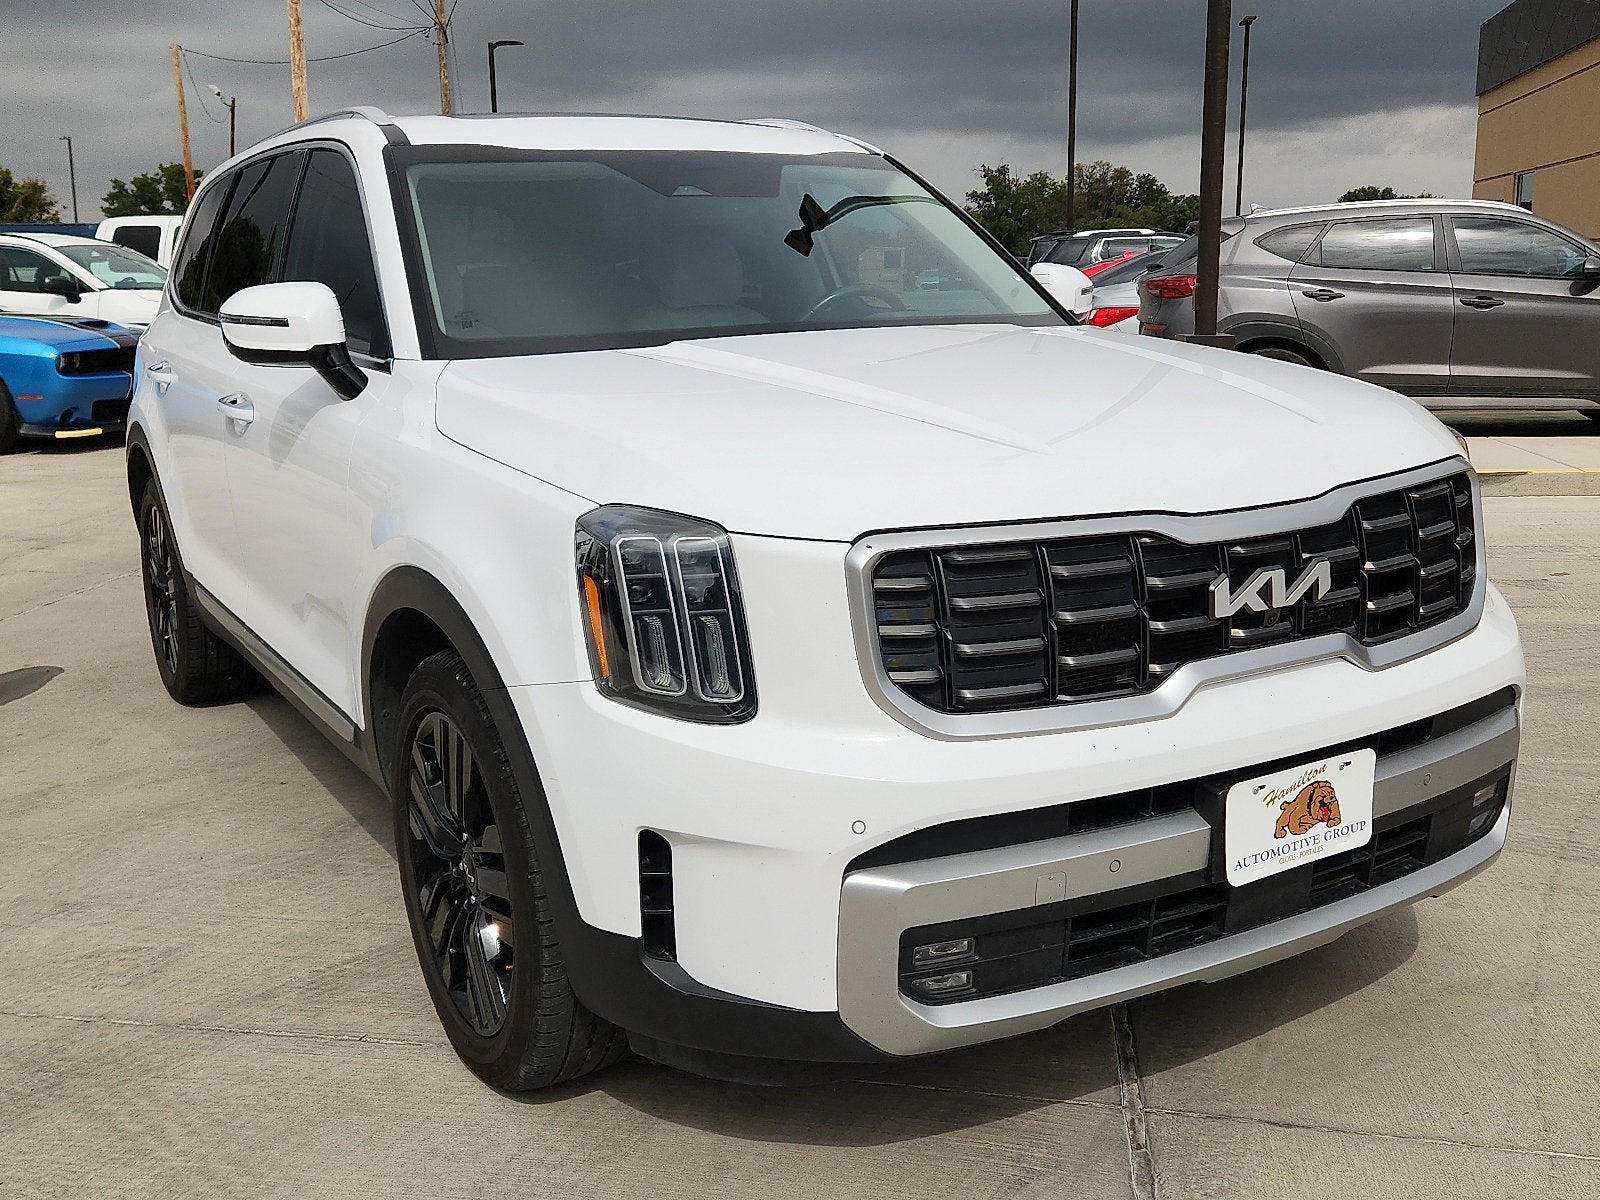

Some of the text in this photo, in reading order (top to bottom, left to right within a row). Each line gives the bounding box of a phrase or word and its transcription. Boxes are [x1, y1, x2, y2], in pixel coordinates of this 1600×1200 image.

[1209, 556, 1331, 619] KIA
[1263, 764, 1327, 808] Hamilton
[1234, 820, 1367, 871] AUTOMOTIVE GROUP
